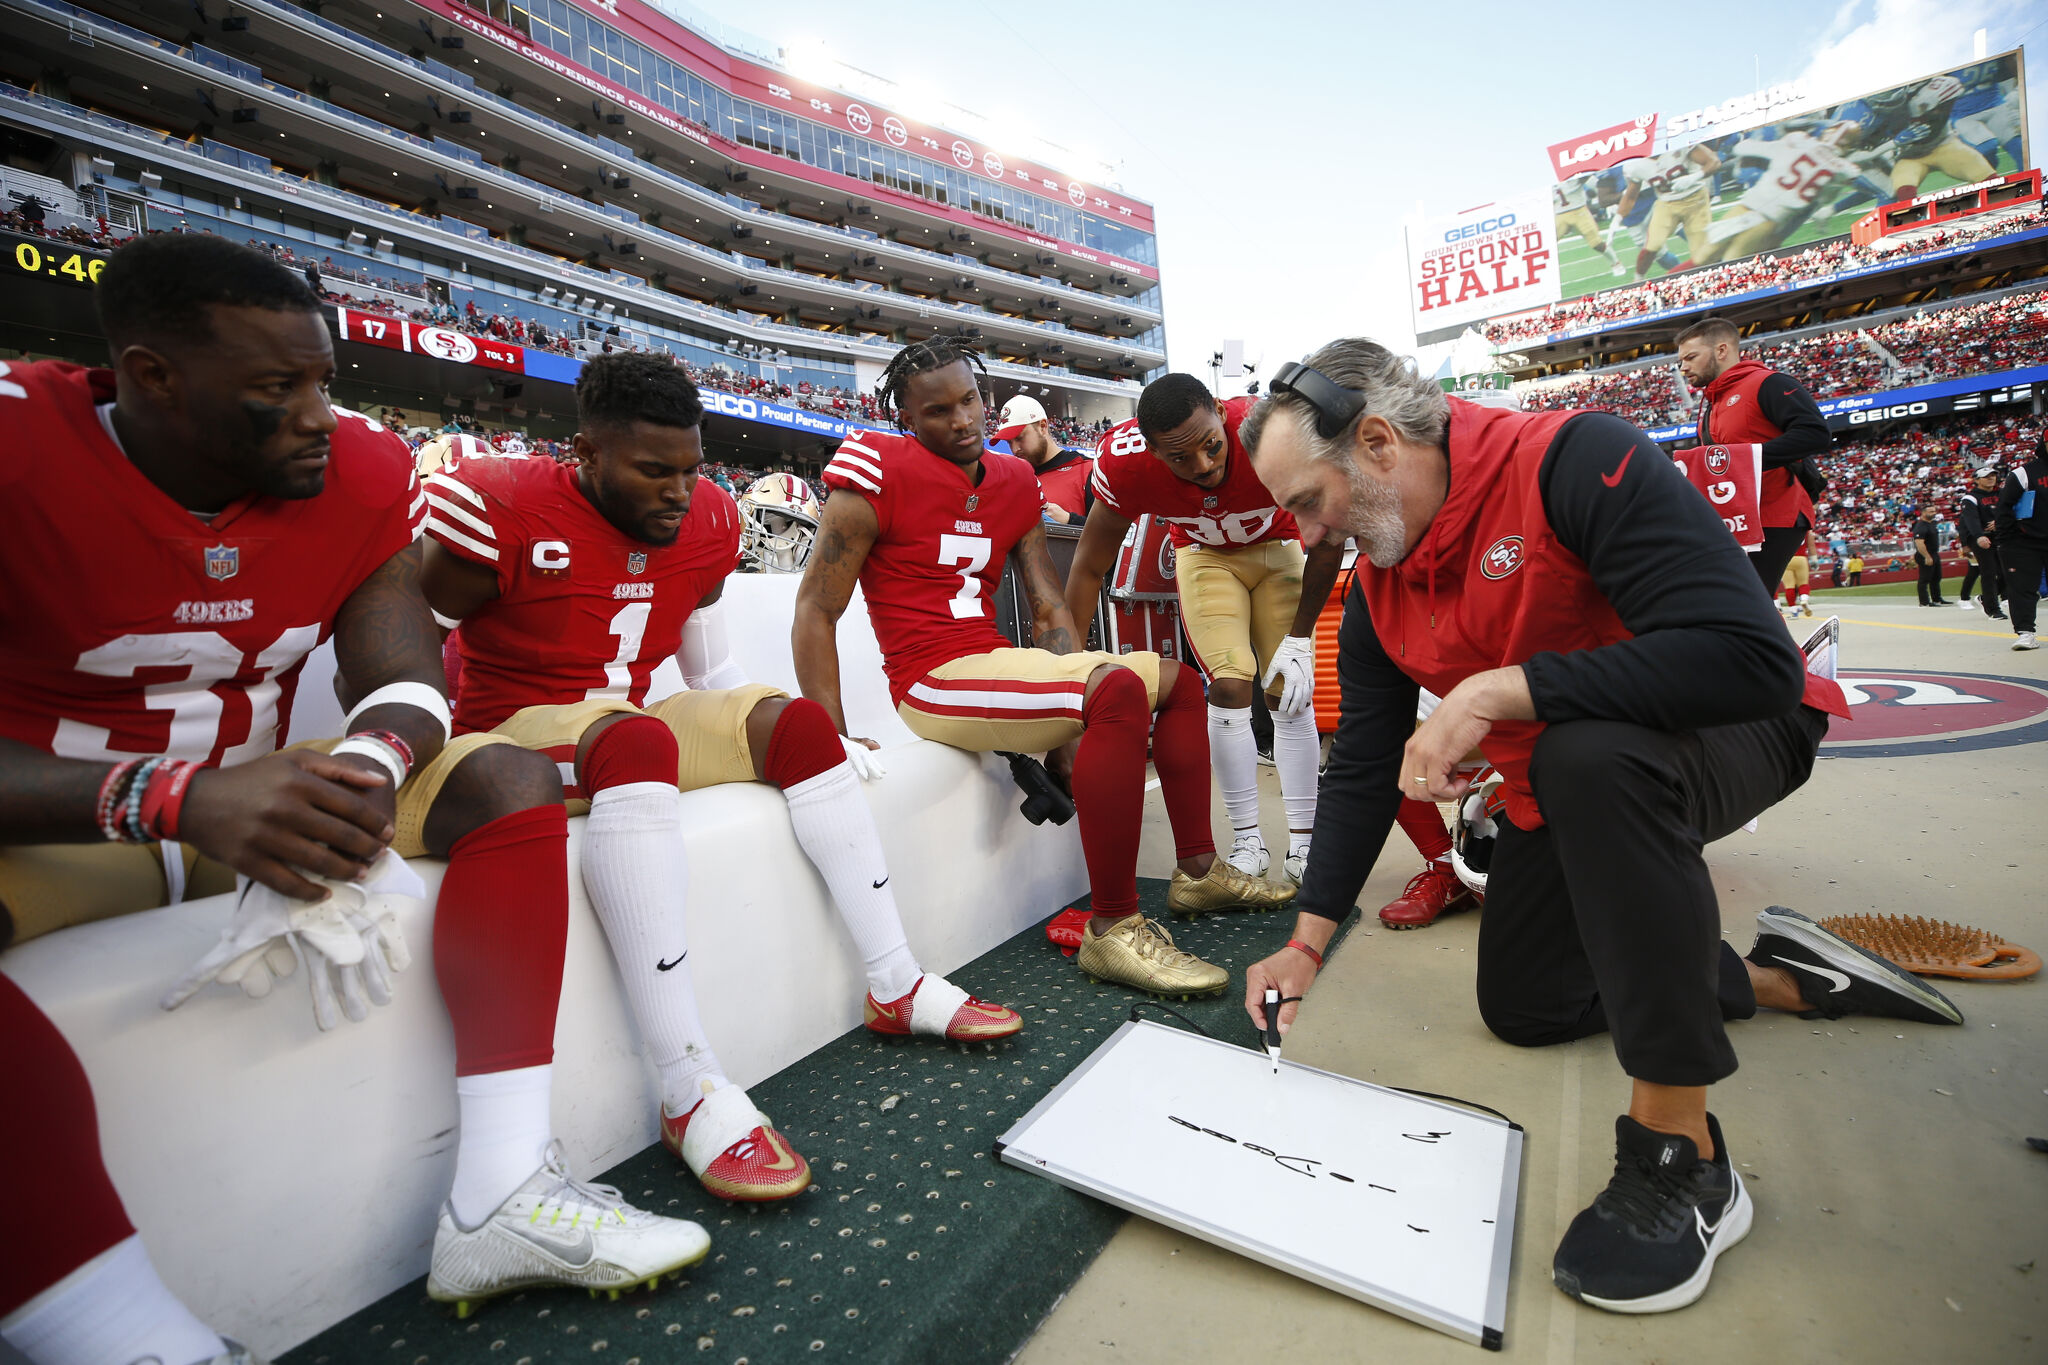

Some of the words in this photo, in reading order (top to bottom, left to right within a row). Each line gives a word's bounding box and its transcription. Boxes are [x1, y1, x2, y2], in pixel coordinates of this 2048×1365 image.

[452, 11, 518, 50] 7-TIME
[521, 44, 626, 104] CONFERENCE
[628, 99, 710, 145] CHAMPIONS
[1955, 176, 2006, 196] STADIUM
[1424, 234, 1494, 259] COUNTDOWN
[1497, 228, 1511, 239] TO
[1514, 221, 1538, 235] THE
[1444, 213, 1516, 243] GEICO
[1027, 235, 1058, 251] WALSH
[1421, 230, 1543, 280] SECOND
[1417, 249, 1550, 312] HALF
[1796, 275, 1836, 289] GEICO
[362, 319, 386, 340] 17
[484, 349, 504, 362] TOL
[506, 352, 515, 364] 3
[697, 388, 757, 419] EICO
[762, 405, 793, 422] Proud
[795, 413, 833, 432] Partner
[834, 421, 845, 433] of
[1837, 397, 1873, 410] 49ers
[1849, 402, 1928, 424] GEICO
[211, 560, 233, 574] NFL
[532, 541, 570, 569] C
[938, 534, 992, 619] 7
[612, 582, 654, 599] 49ERS
[172, 598, 254, 624] 49ERS
[584, 602, 652, 701] 1
[51, 622, 322, 769] 31
